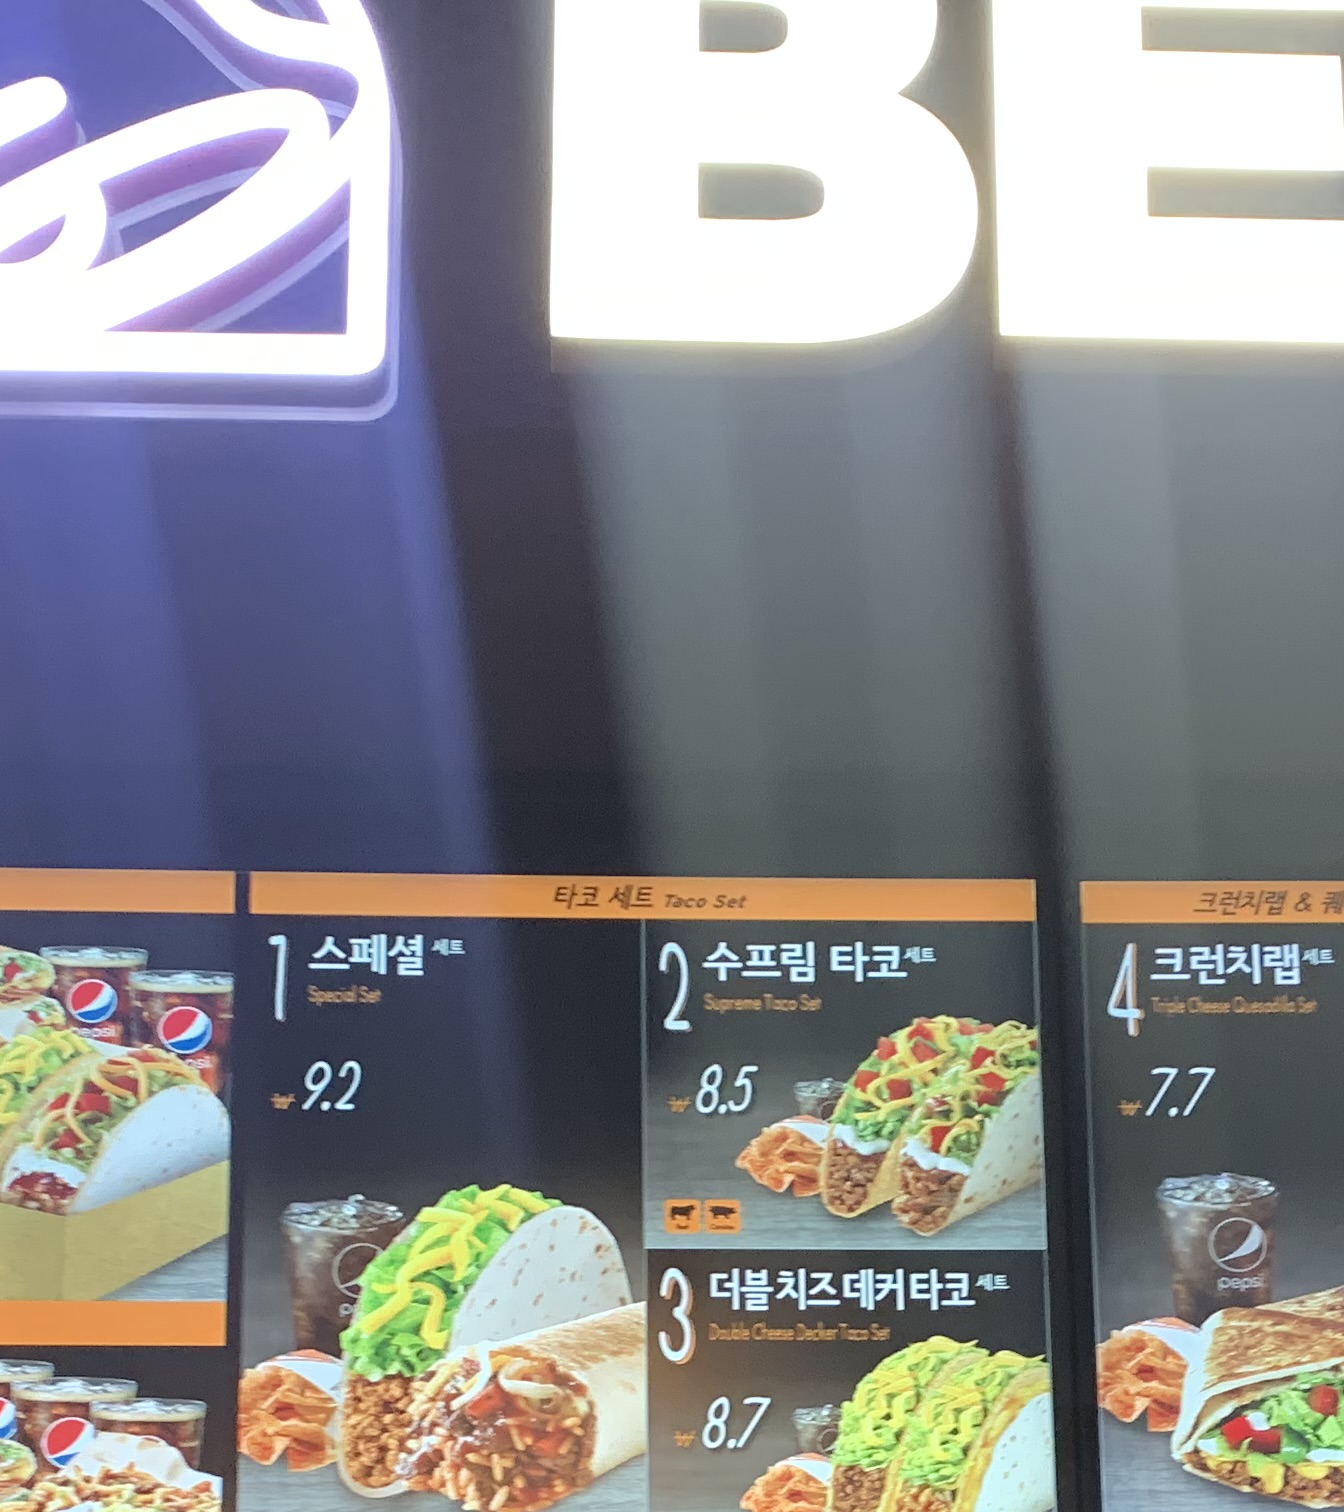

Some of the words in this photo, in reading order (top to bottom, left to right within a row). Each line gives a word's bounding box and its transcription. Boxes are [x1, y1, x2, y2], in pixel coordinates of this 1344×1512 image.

[554, 883, 599, 910] 타코
[608, 884, 653, 910] 세트
[663, 894, 707, 909] Taco
[714, 894, 748, 909] Set
[1193, 889, 1286, 916] 크런치랩
[1294, 891, 1312, 912] &
[308, 934, 425, 977] 스페셜
[431, 939, 466, 956] 세트
[702, 941, 816, 983] 수프림
[830, 941, 908, 983] 타코
[904, 947, 936, 964] 세트
[1150, 943, 1302, 985] 크런치랩
[1301, 948, 1336, 966] 세트
[268, 934, 287, 1023] 1
[306, 985, 357, 1006] Special
[358, 985, 383, 1005] Set
[658, 942, 692, 1031] 2
[1107, 943, 1145, 1037] 4
[703, 993, 762, 1014] Supreme
[763, 993, 798, 1011] Taco
[800, 993, 823, 1011] Set
[301, 1060, 363, 1111] 9.2
[695, 1064, 759, 1115] 8.5
[1145, 1066, 1216, 1117] 7.7
[976, 1274, 1010, 1291] 세트
[1217, 1273, 1264, 1291] pepsi
[658, 1267, 696, 1365] 3
[708, 1323, 750, 1341] Double
[751, 1323, 794, 1341] Cheese
[838, 1323, 870, 1340] Taco
[702, 1396, 772, 1449] 8.7
